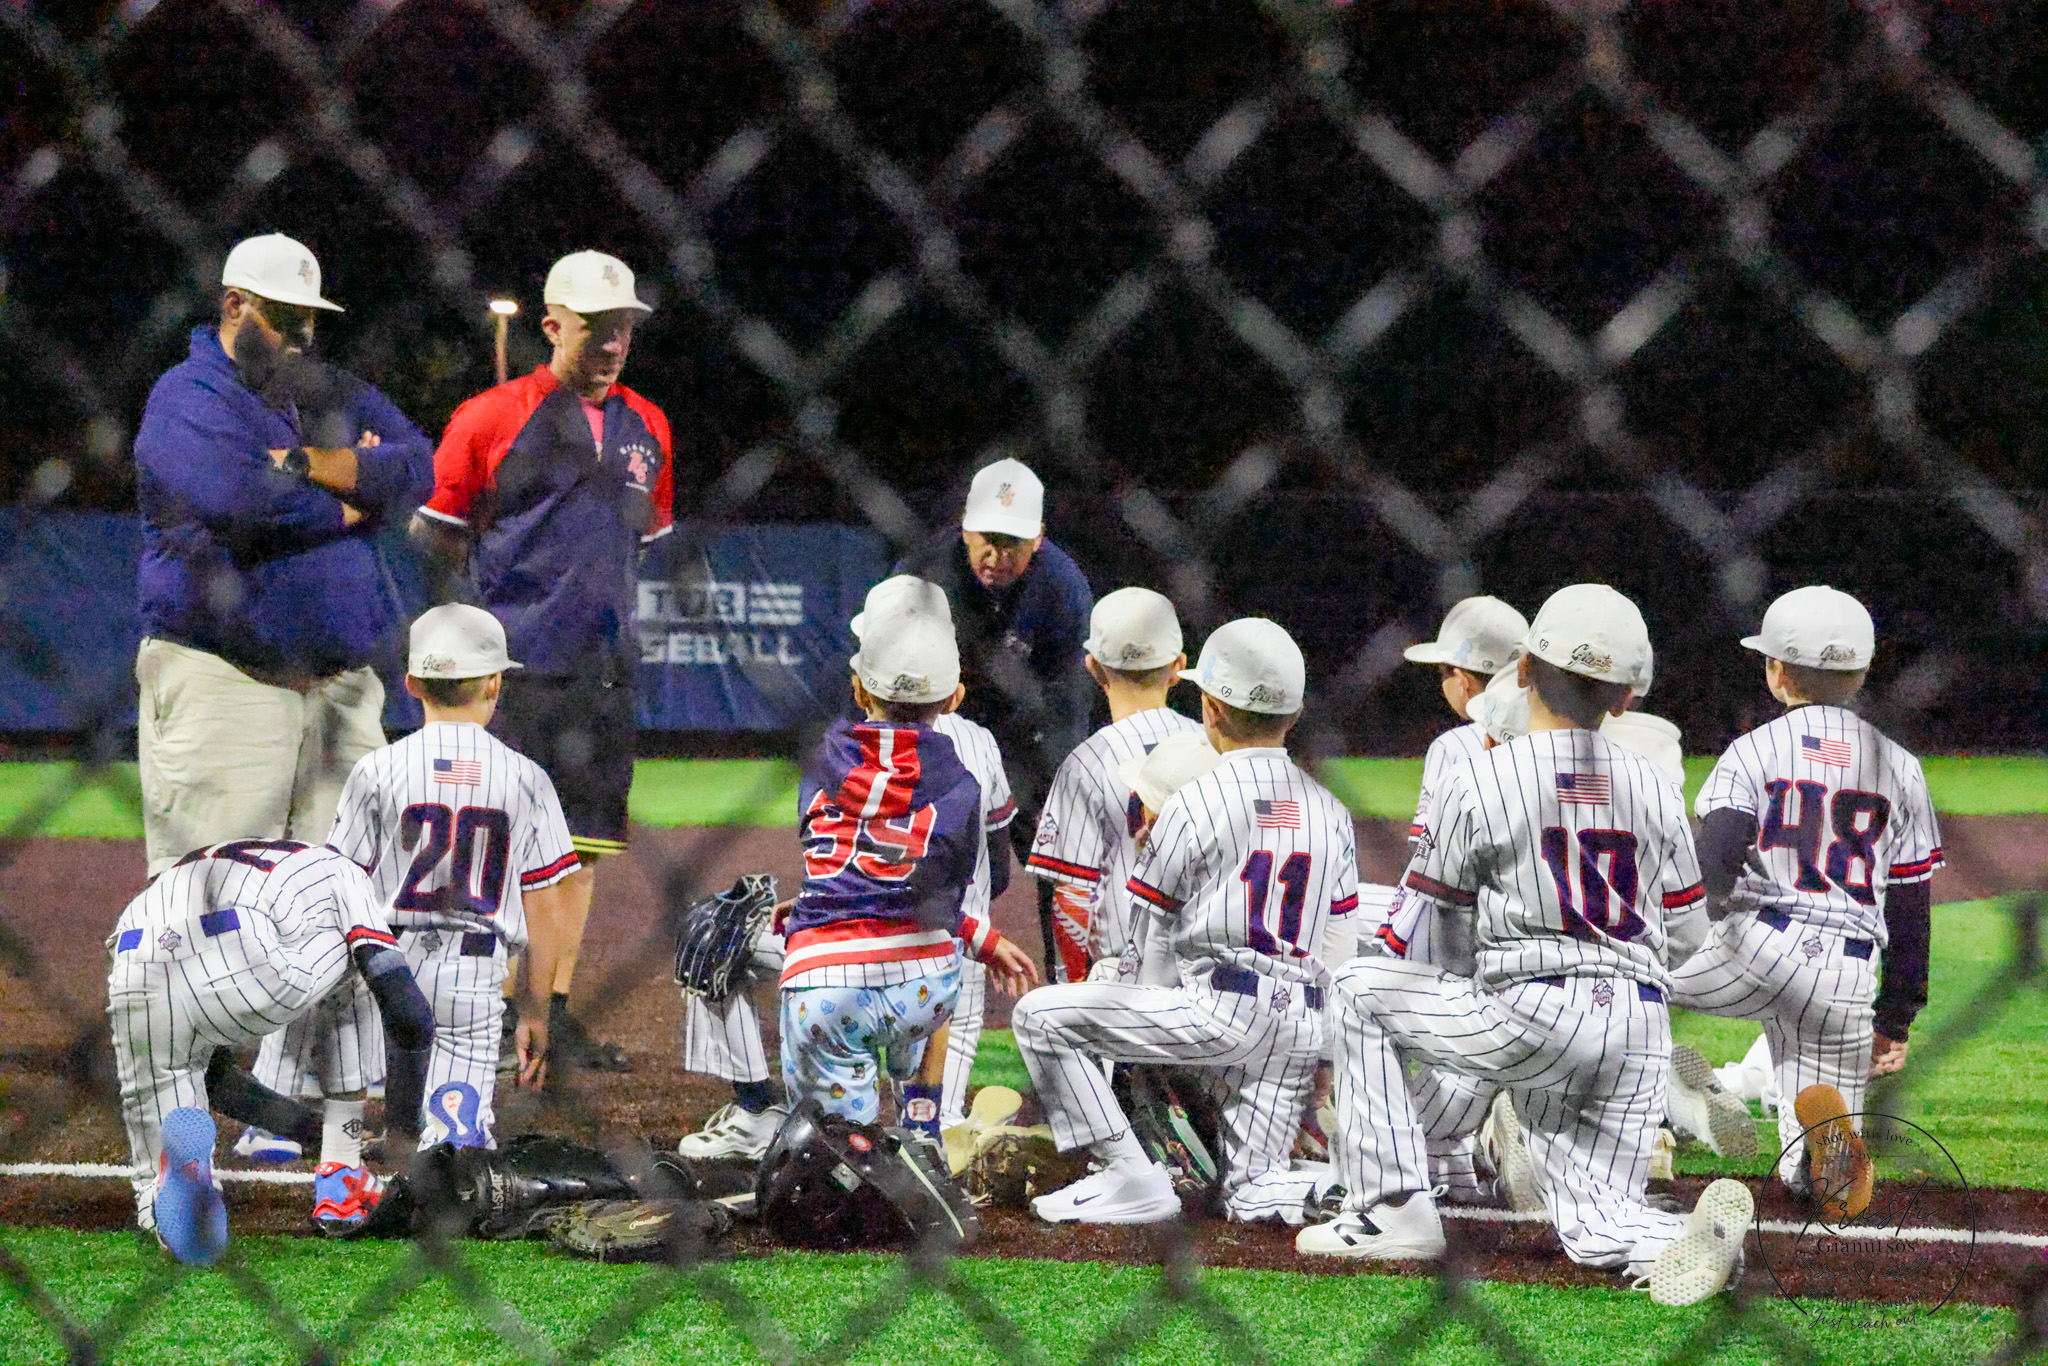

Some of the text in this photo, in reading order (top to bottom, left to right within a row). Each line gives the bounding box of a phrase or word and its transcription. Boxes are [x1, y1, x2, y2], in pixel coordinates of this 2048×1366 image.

[394, 802, 511, 917] 20
[1541, 826, 1647, 942] 10
[1759, 777, 1892, 906] 48
[1240, 849, 1312, 958] 11
